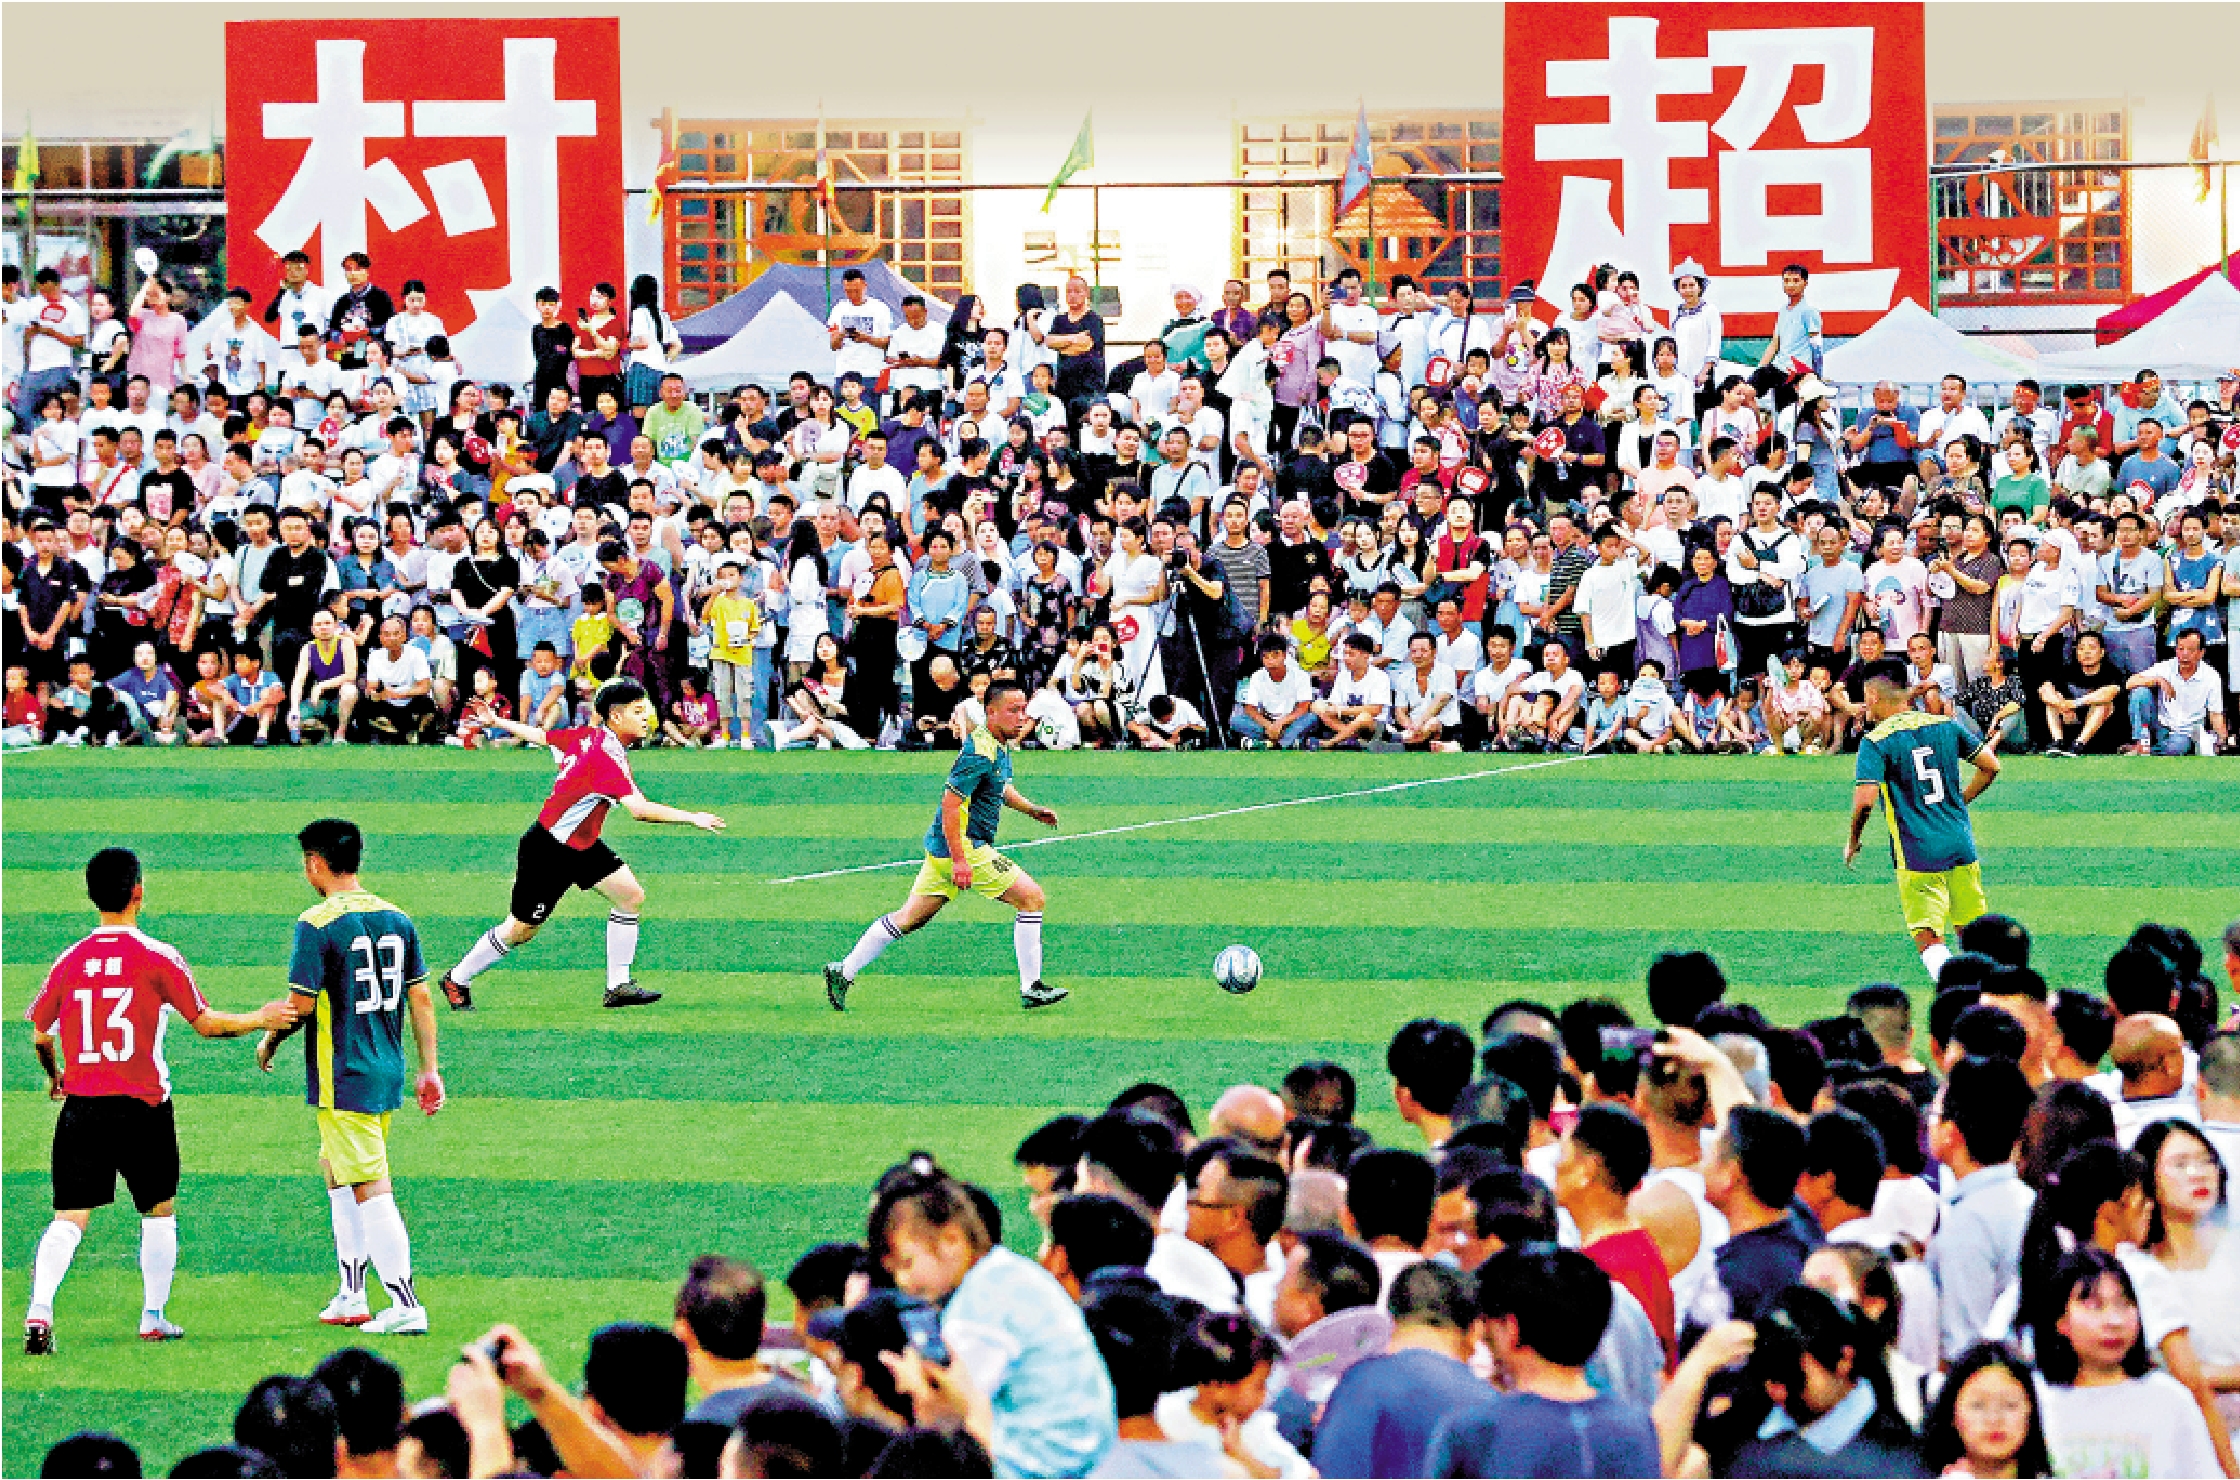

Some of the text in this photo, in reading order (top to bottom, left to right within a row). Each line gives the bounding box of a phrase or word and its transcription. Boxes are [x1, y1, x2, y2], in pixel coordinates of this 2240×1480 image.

[254, 38, 597, 326] 村
[1535, 16, 1900, 314] 超
[1911, 746, 1945, 805] 5
[531, 902, 547, 920] 2
[350, 934, 405, 1014] 33
[73, 987, 135, 1064] 13
